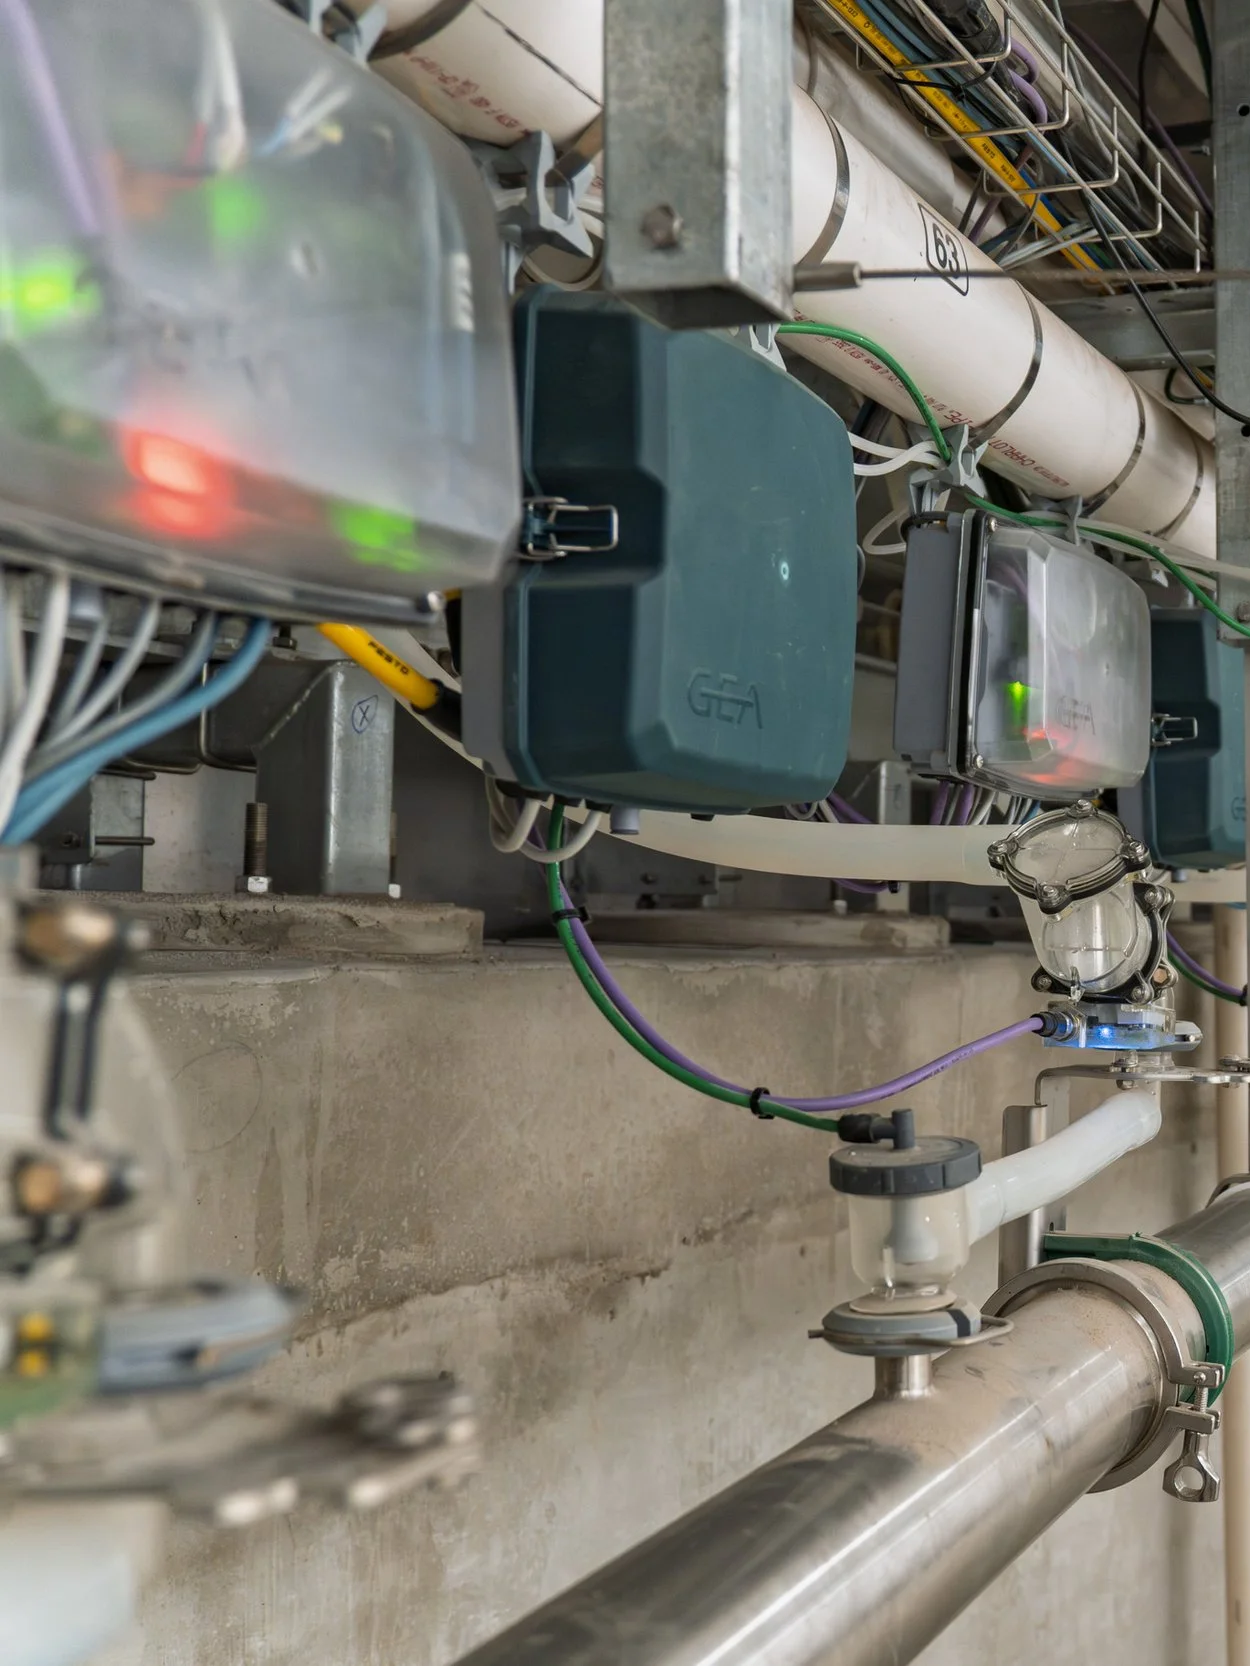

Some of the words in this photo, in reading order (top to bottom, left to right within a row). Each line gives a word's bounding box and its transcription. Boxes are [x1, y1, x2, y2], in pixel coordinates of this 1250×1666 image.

[932, 222, 961, 279] 63
[368, 641, 409, 676] FESTO
[687, 666, 763, 729] GEA
